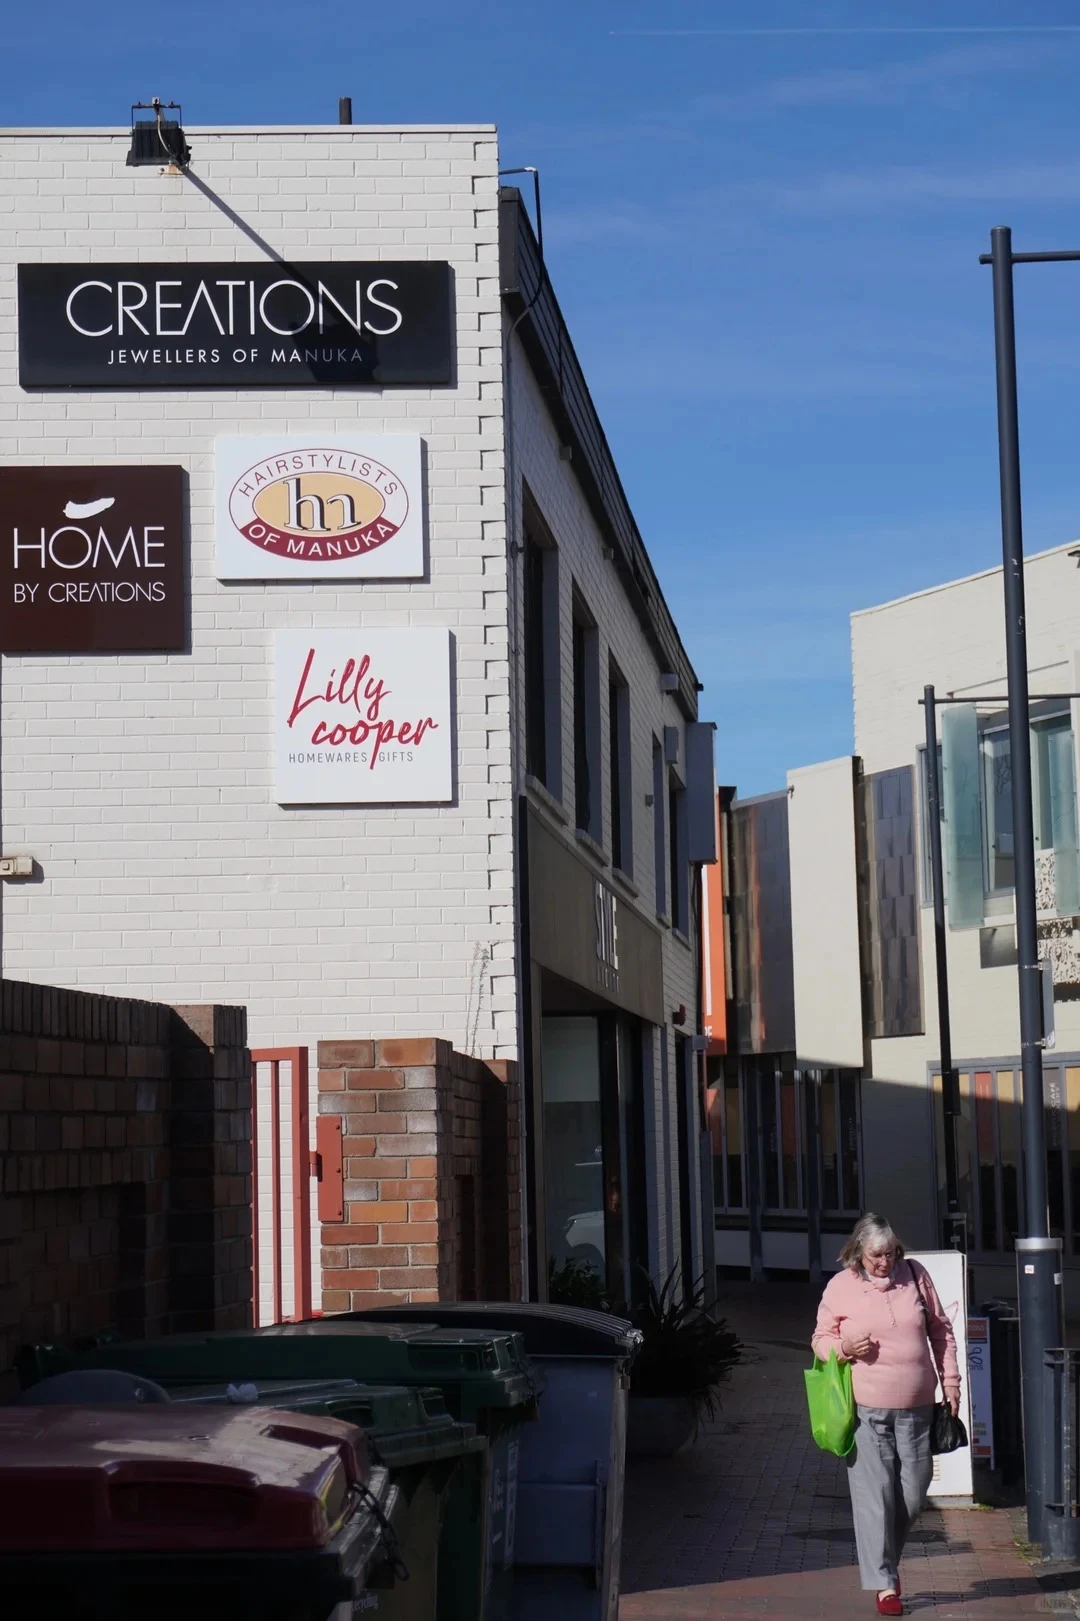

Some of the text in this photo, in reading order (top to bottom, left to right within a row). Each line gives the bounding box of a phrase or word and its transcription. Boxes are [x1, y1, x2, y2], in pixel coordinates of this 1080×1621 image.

[66, 279, 402, 337] CREATIONS
[108, 348, 363, 365] JEWELLERS OF MANUKA
[239, 454, 398, 498] HAIRSTYLISTS
[13, 526, 165, 569] HOME
[248, 523, 393, 556] OF MANUKA
[14, 582, 166, 602] BY CREATIONS
[287, 648, 392, 728] Lilly
[289, 751, 413, 763] HOMEWARES GIFTS
[311, 717, 438, 770] cooper
